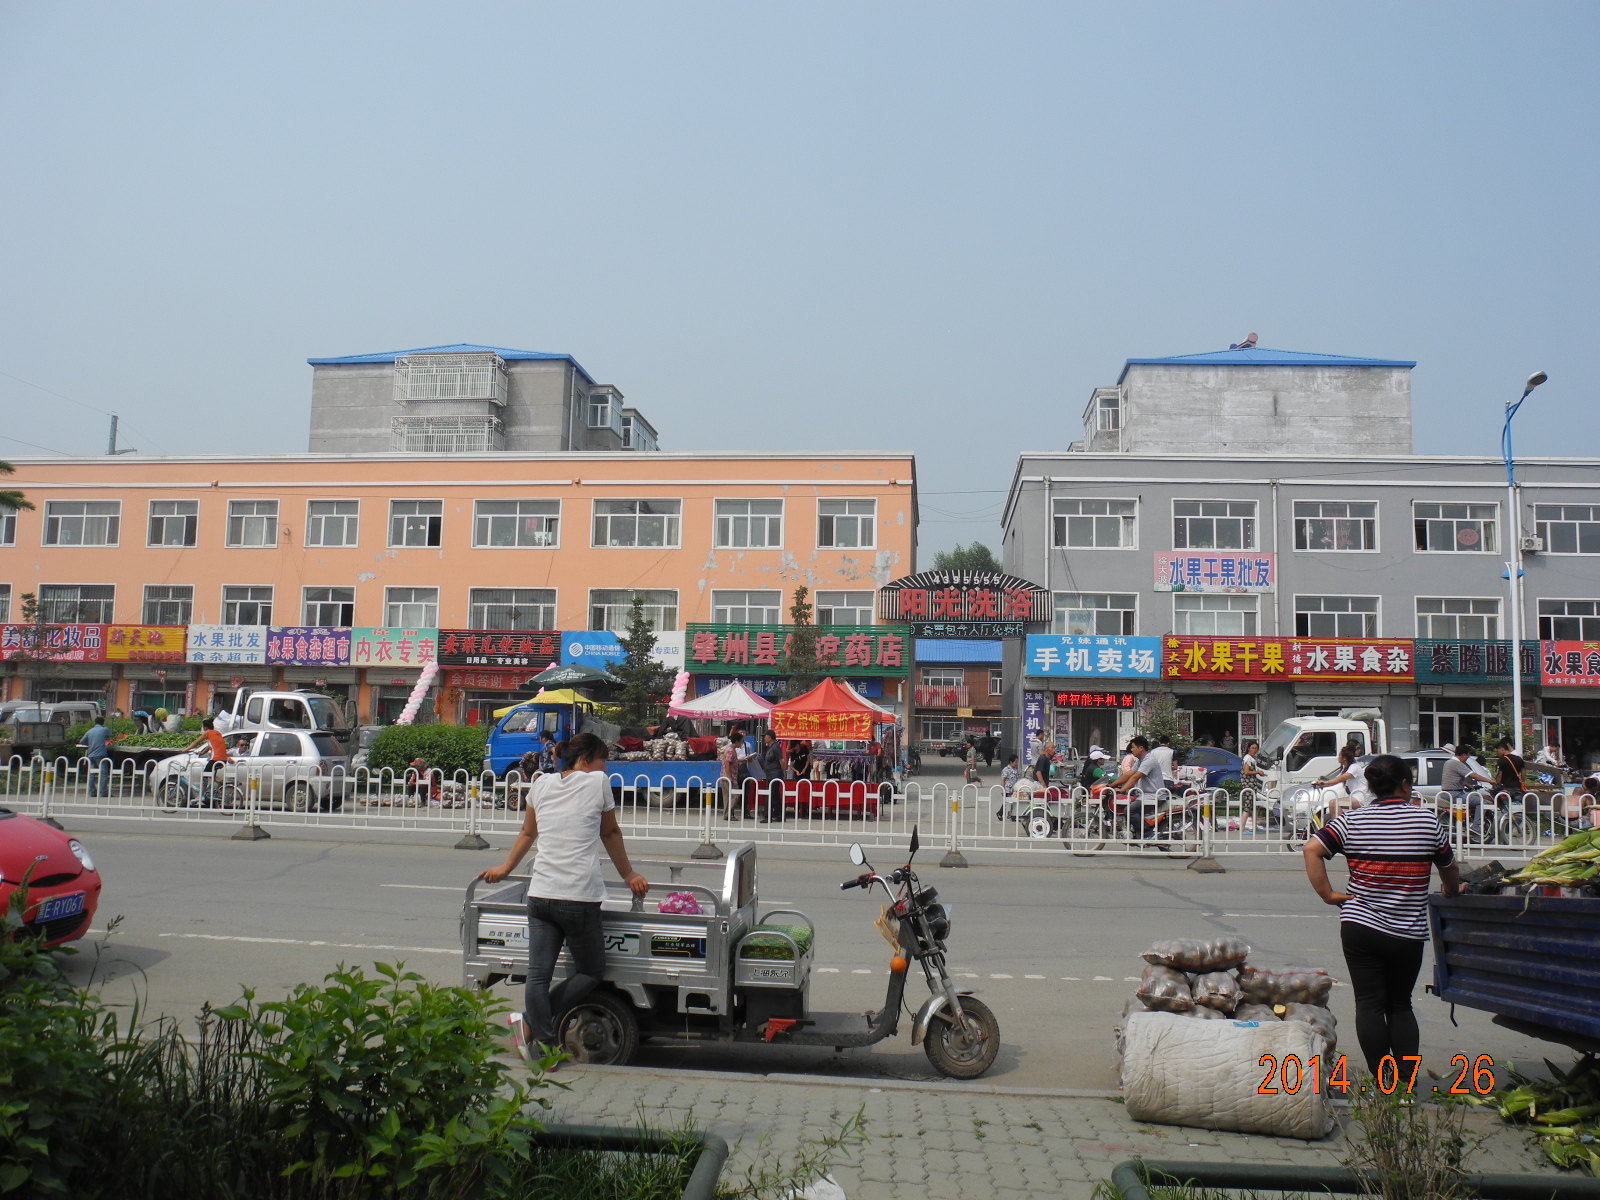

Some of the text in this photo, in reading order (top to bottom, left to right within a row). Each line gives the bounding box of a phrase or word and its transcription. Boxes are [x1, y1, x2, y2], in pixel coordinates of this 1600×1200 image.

[933, 575, 1001, 586] 4395555
[1169, 557, 1270, 587] 水果干果批发
[899, 587, 1033, 618] 阳光洗浴
[193, 632, 260, 648] 水果批发
[267, 635, 350, 661] 水果食杂超市
[355, 636, 435, 663] 内衣专卖
[691, 631, 904, 668] 肇州县谊药店
[1061, 636, 1128, 646] 兄妹通讯
[191, 651, 260, 663] 食杂超市
[1033, 648, 1155, 674] 手机卖场
[1166, 637, 1182, 677] 徐大波
[1183, 640, 1285, 674] 水果干果
[1306, 645, 1409, 674] 水果食杂
[451, 672, 503, 688] 会员答谢
[708, 679, 787, 693] 朝阳镇新农保
[1024, 692, 1043, 700] 兄妹
[1121, 693, 1133, 707] 保
[826, 713, 871, 732] 特价下乡
